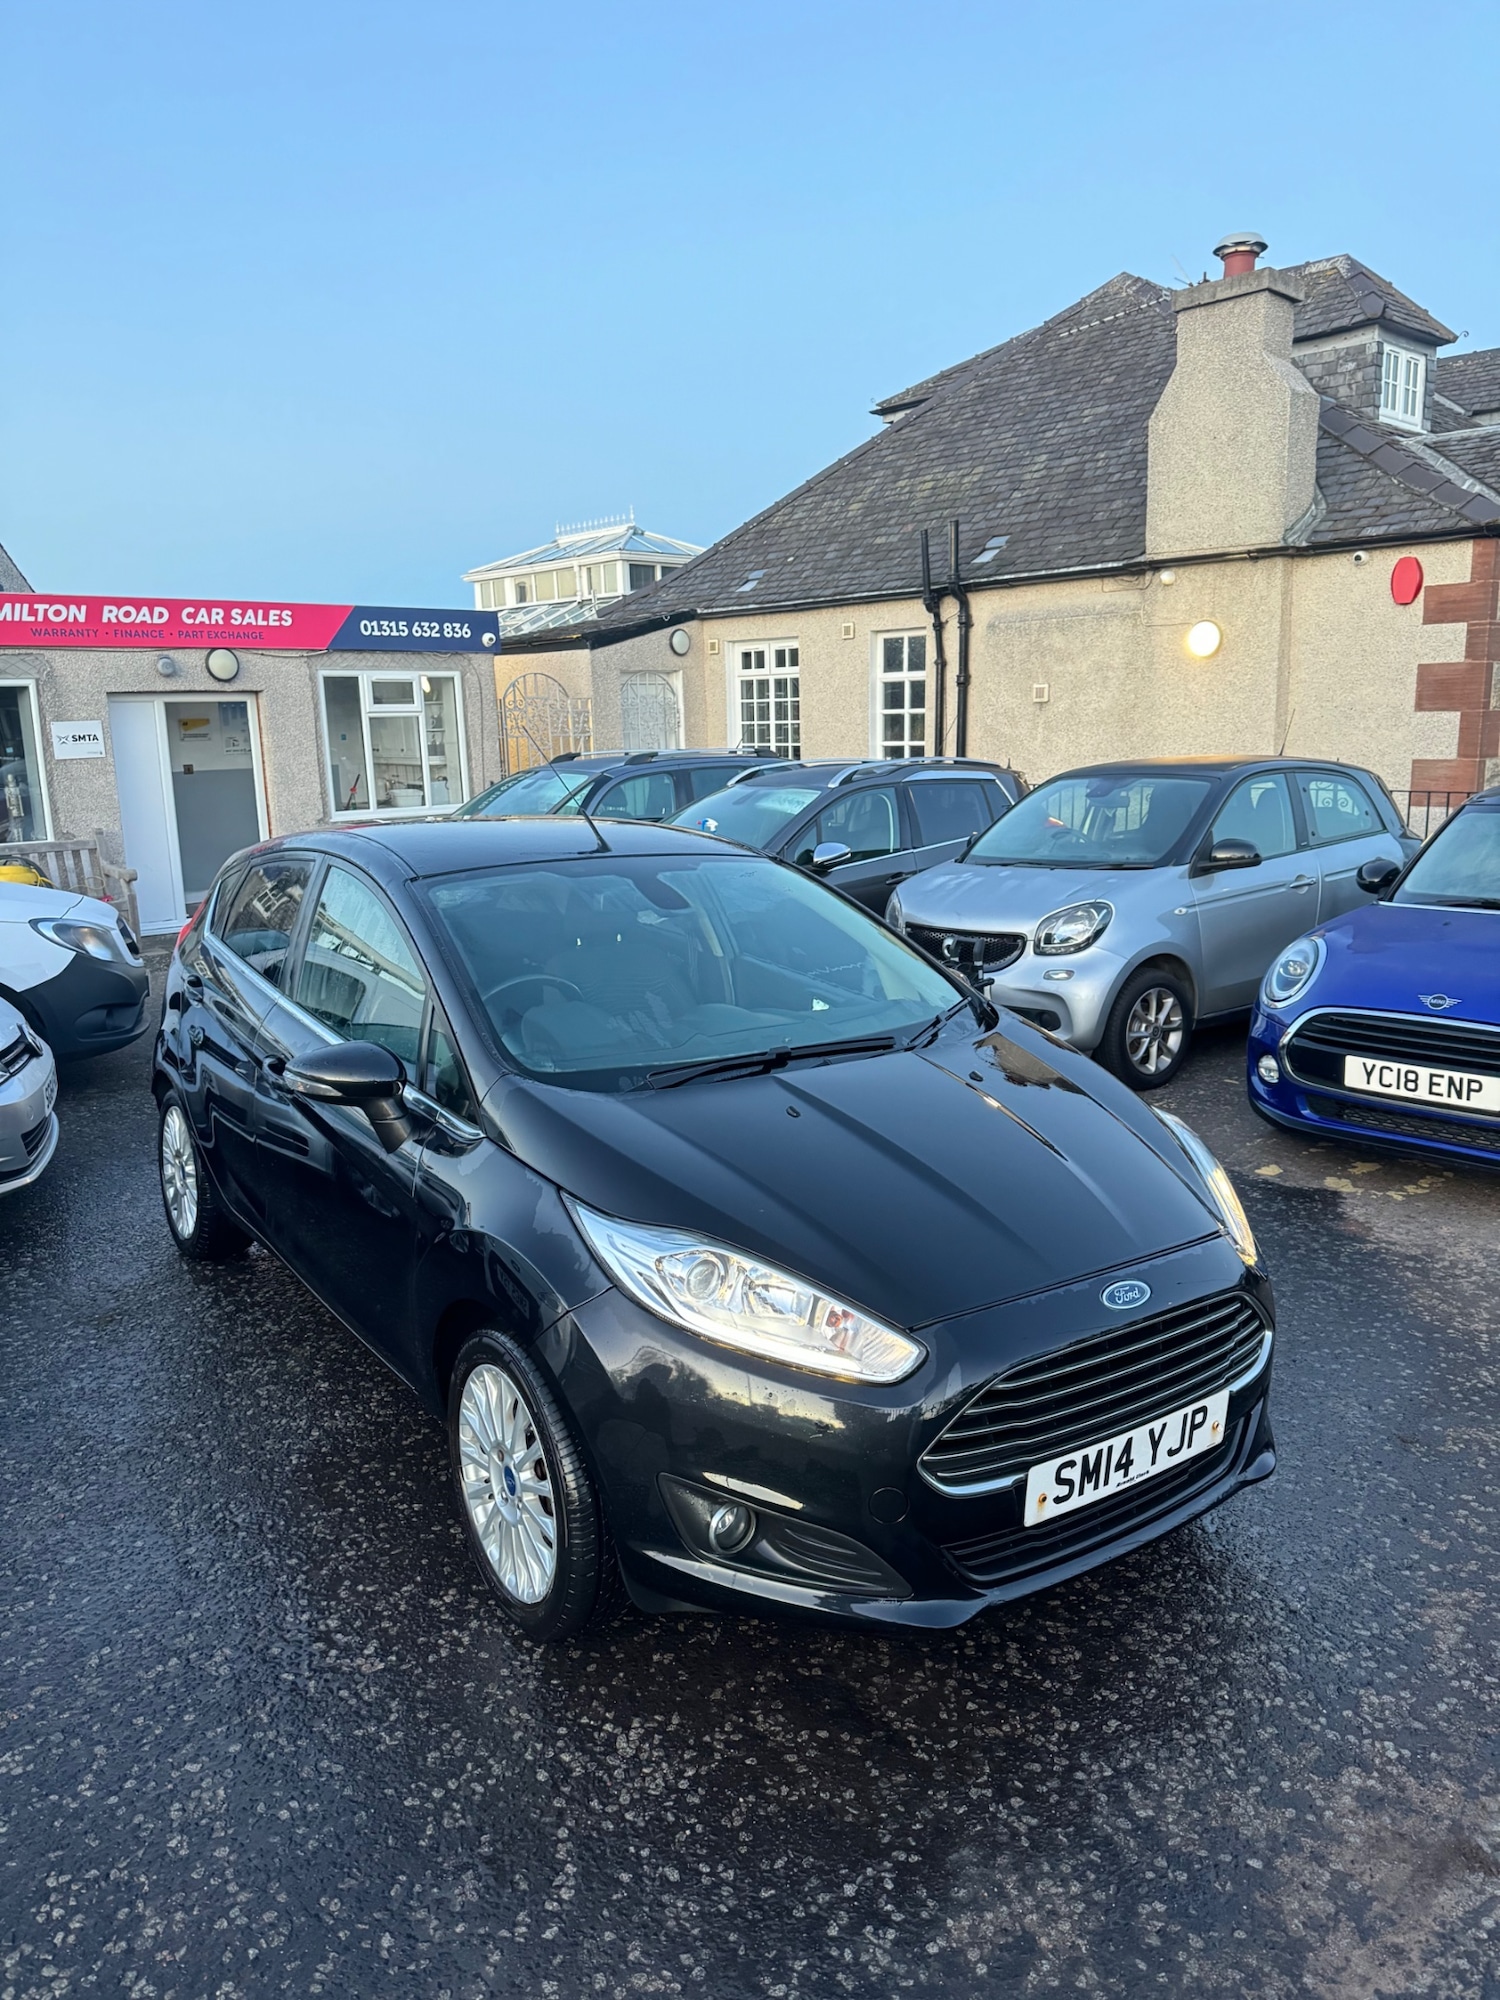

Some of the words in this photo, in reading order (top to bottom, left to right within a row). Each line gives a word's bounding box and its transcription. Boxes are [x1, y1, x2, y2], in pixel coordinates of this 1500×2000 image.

[0, 603, 87, 622] MILTON
[102, 605, 169, 624] ROAD
[181, 607, 224, 624] CAR
[230, 608, 292, 626] SALES
[31, 628, 99, 638] WARRANTY
[114, 629, 164, 638] FINANCE
[178, 630, 204, 639] PART
[207, 631, 264, 640] EXCHANGE
[360, 619, 409, 636] 01315
[412, 621, 440, 638] 632
[443, 622, 471, 638] 836
[71, 734, 99, 742] SMTA
[1362, 1061, 1419, 1092] YC18
[1428, 1072, 1483, 1101] ENP
[1114, 1286, 1140, 1304] Ford
[1052, 1437, 1134, 1505] SM14
[1148, 1405, 1208, 1467] YJP
